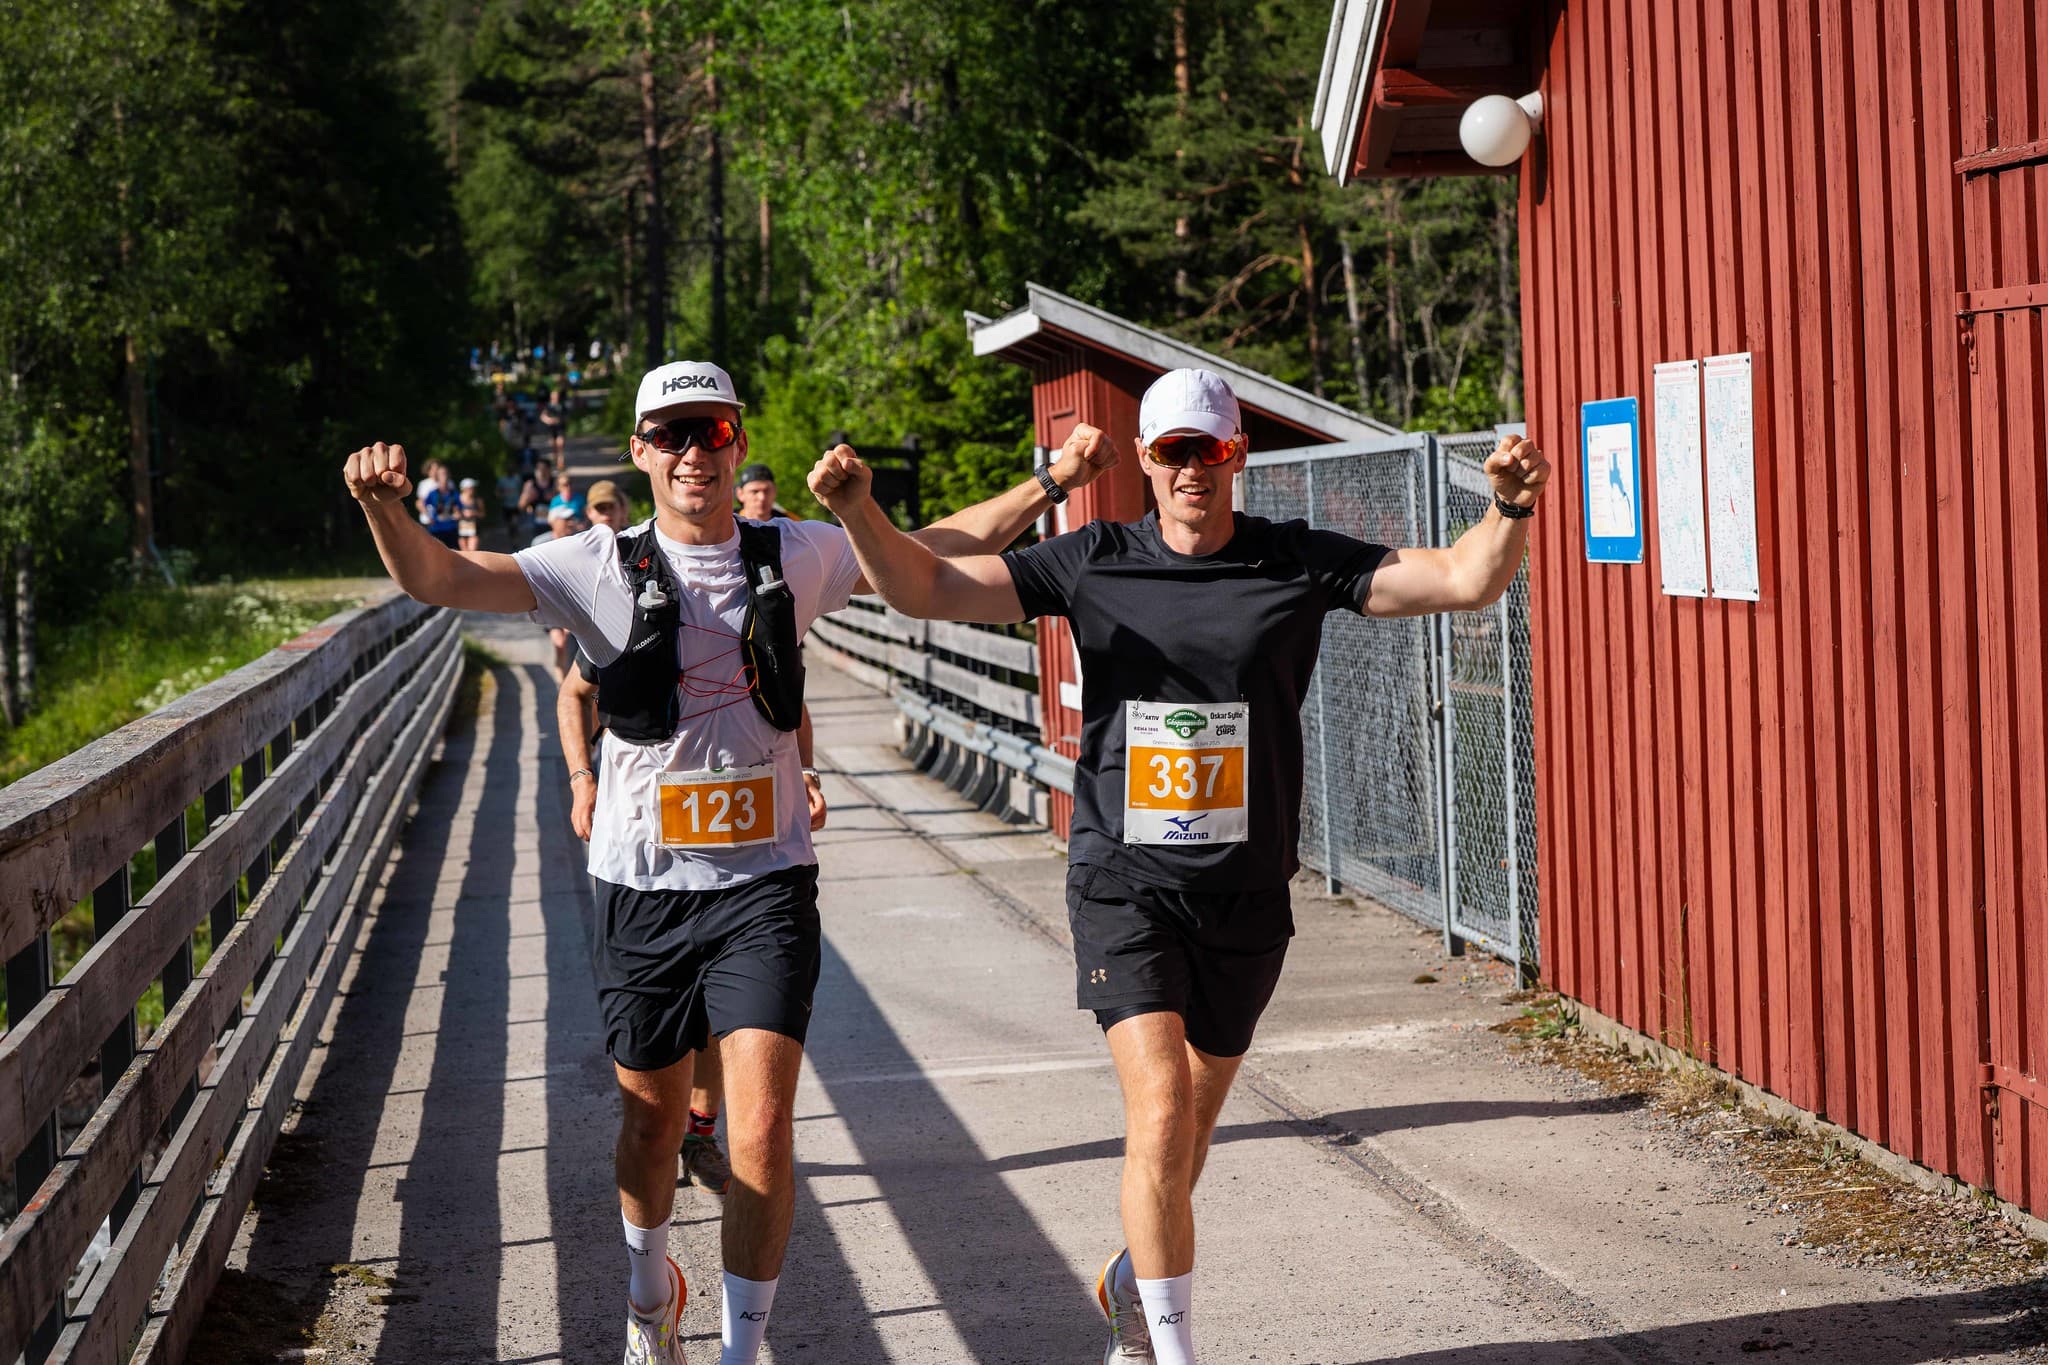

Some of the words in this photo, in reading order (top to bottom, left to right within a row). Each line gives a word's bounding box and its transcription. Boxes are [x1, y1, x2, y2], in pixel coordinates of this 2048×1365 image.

[662, 375, 718, 396] HOKA
[1148, 754, 1224, 800] 337
[682, 787, 757, 833] 123
[1162, 831, 1209, 840] MIZUNO
[627, 1244, 652, 1257] ACT
[739, 1311, 768, 1322] ACT
[1158, 1311, 1185, 1326] ACT
